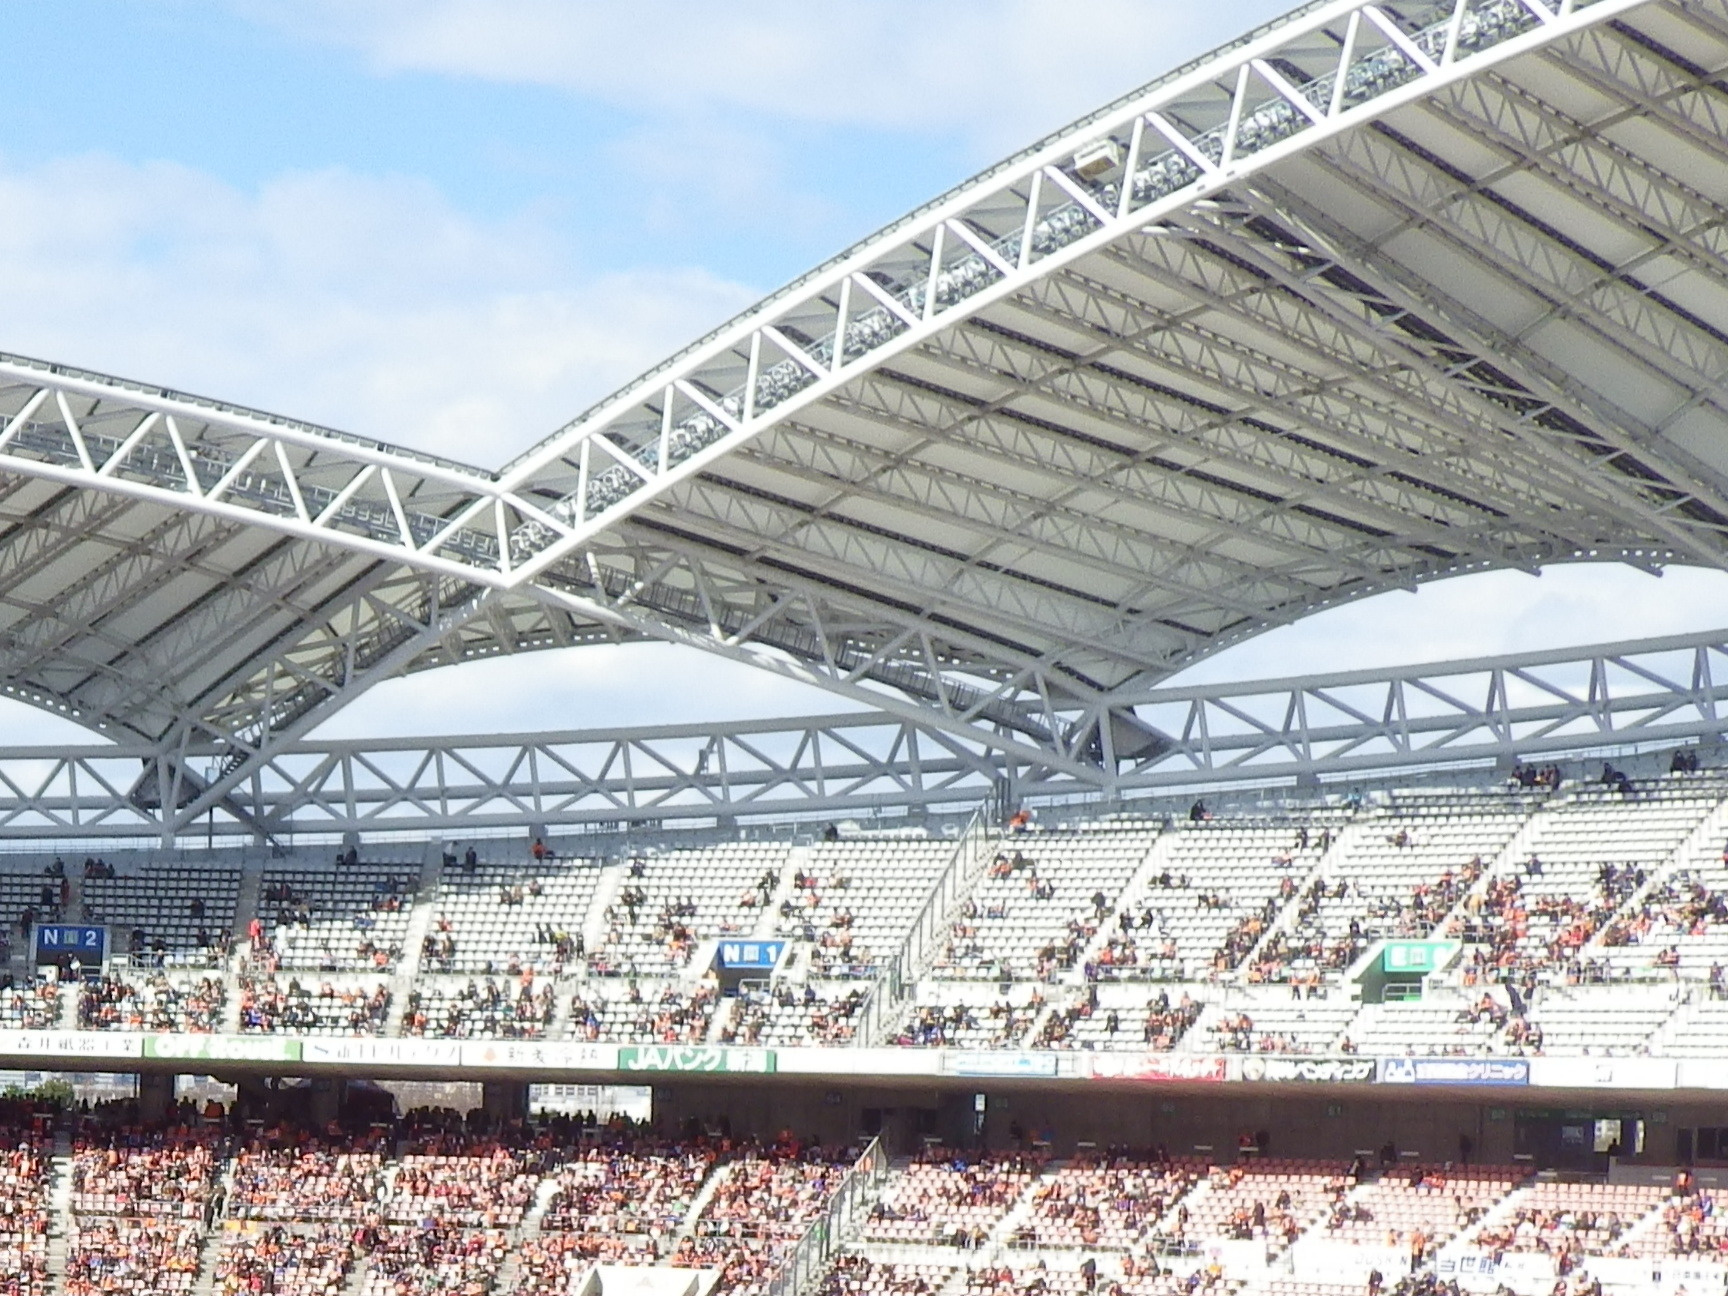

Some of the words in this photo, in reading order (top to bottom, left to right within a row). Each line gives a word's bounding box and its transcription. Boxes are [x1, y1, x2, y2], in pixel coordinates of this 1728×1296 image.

[44, 929, 58, 945] N
[85, 930, 97, 946] 2
[724, 945, 740, 961] N
[766, 946, 777, 962] 1
